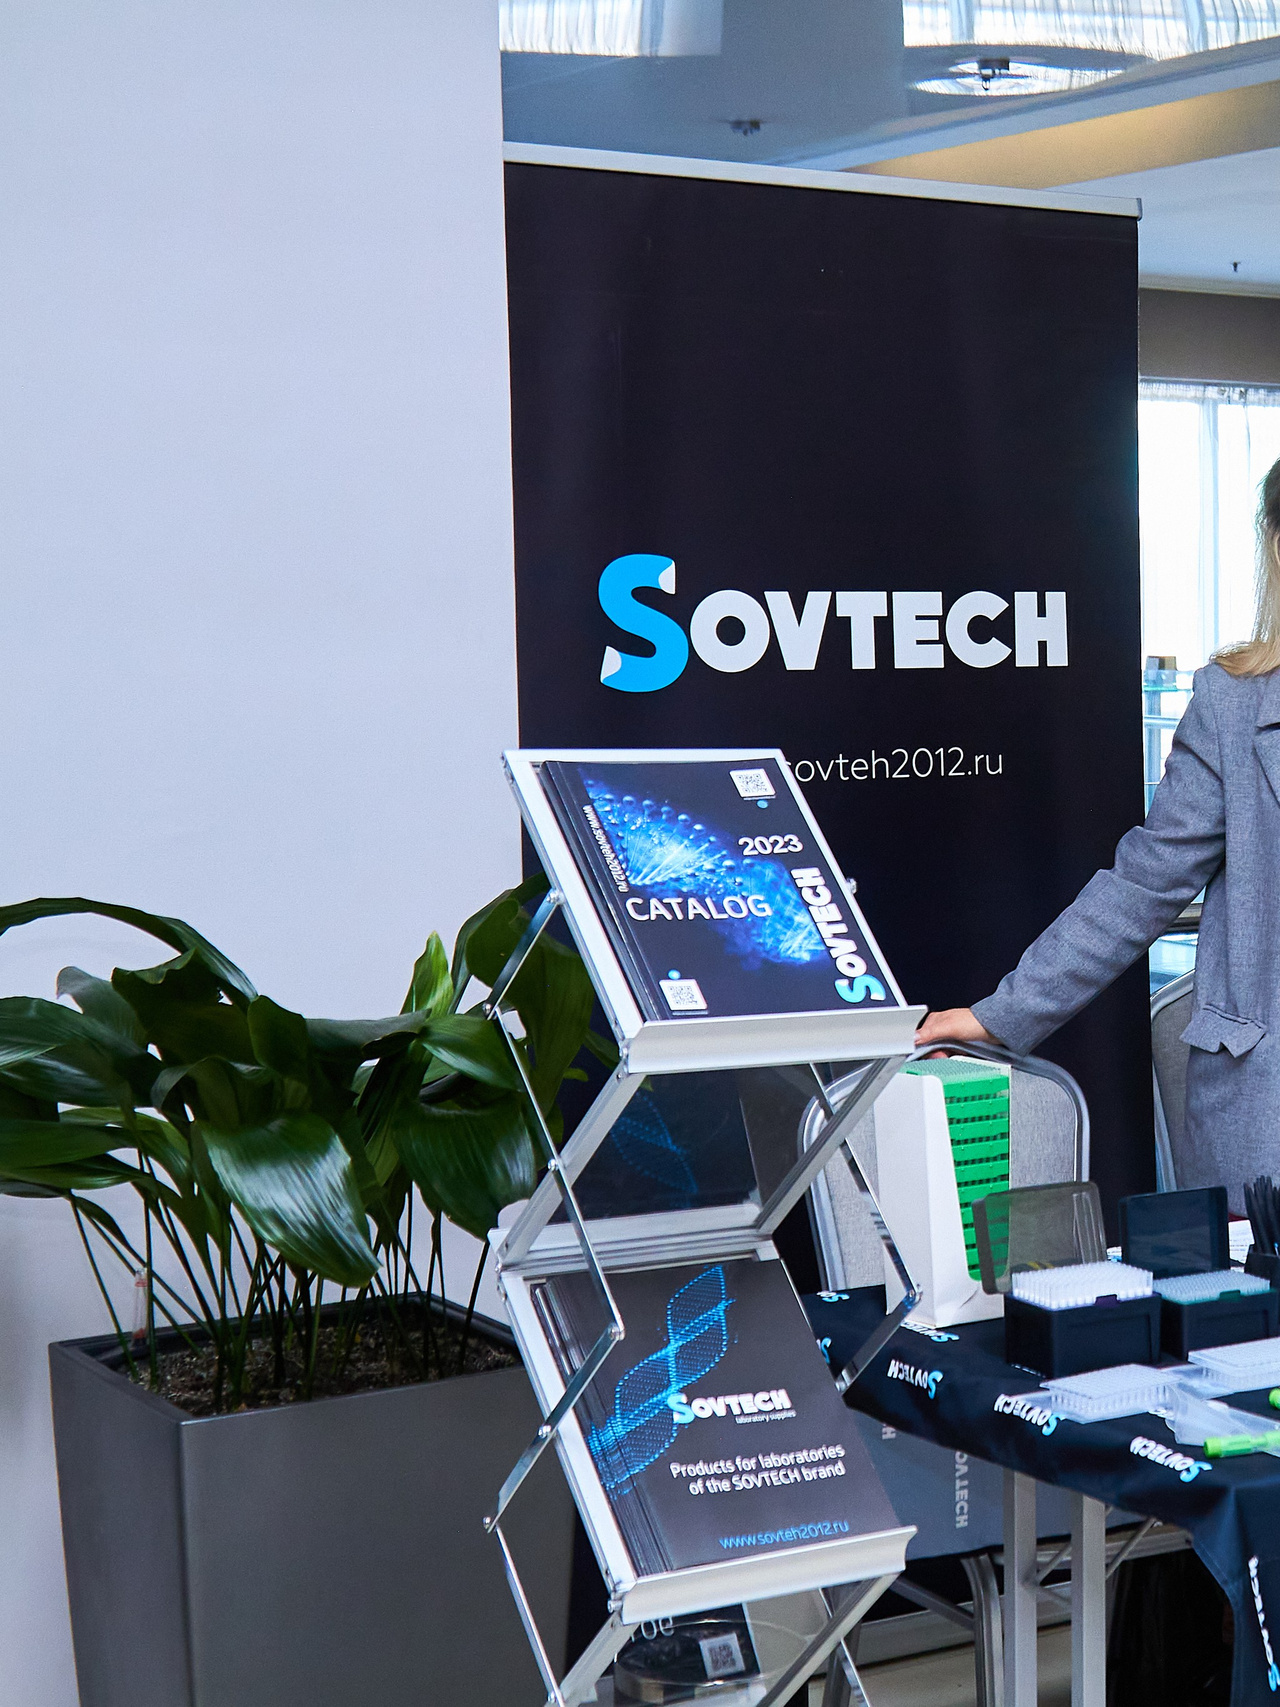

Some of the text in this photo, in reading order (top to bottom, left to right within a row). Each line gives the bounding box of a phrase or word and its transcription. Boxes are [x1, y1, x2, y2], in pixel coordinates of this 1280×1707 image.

[597, 553, 1070, 693] SOVTECH
[784, 746, 1003, 783] ovteh2012.ru
[582, 804, 630, 893] www.sovteh2012.ru
[738, 834, 804, 856] 2023
[624, 894, 774, 922] CATALOG
[790, 867, 887, 1004] SOVTECH
[887, 1358, 943, 1400] SOVTECH
[667, 1388, 793, 1425] SOVTECH
[669, 1443, 846, 1479] Products for laboratories
[688, 1460, 847, 1496] of the SOVTECH brand
[719, 1520, 850, 1550] www.sovteh2012.ru
